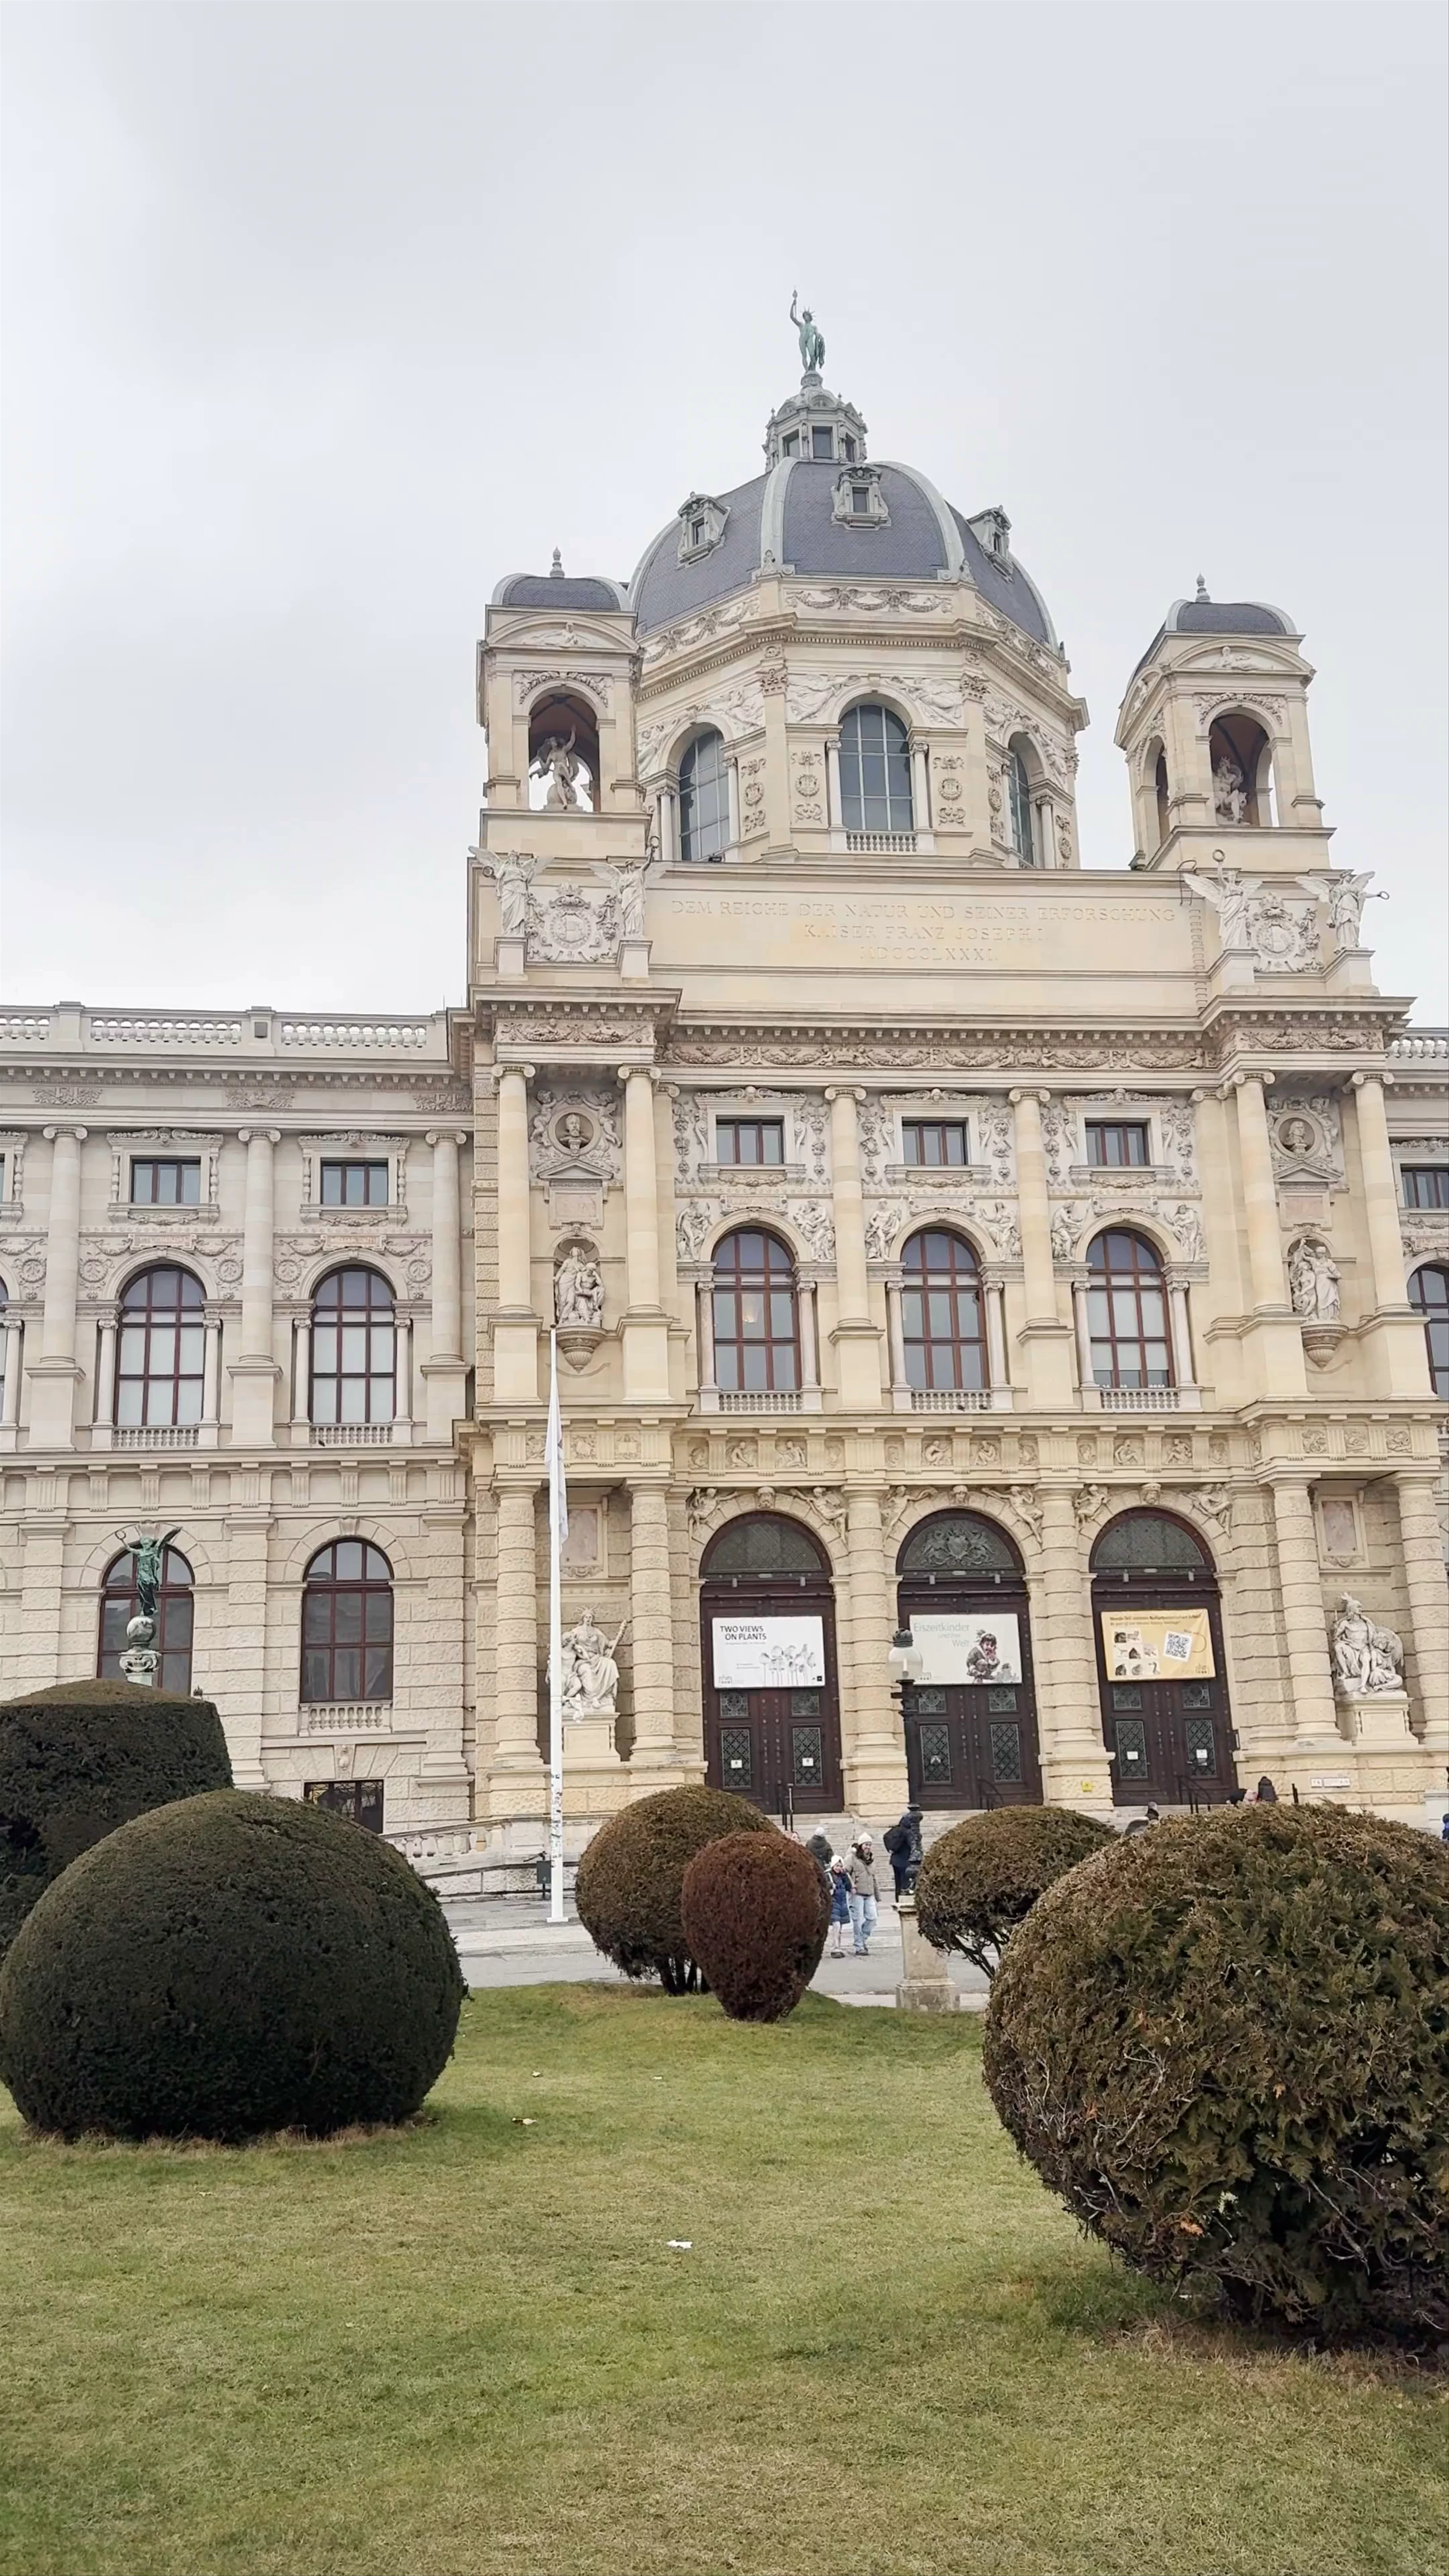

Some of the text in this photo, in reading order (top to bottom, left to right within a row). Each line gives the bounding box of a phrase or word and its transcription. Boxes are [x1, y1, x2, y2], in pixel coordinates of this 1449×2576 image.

[671, 900, 1176, 921] DEM REICHE DER NATUR UND SEINER ERFORSCHUNG
[804, 924, 877, 938] KAISER
[885, 926, 945, 940] FRANZ
[954, 927, 1031, 941] JOSEPH
[913, 1622, 969, 1632] Eiszeitkinder
